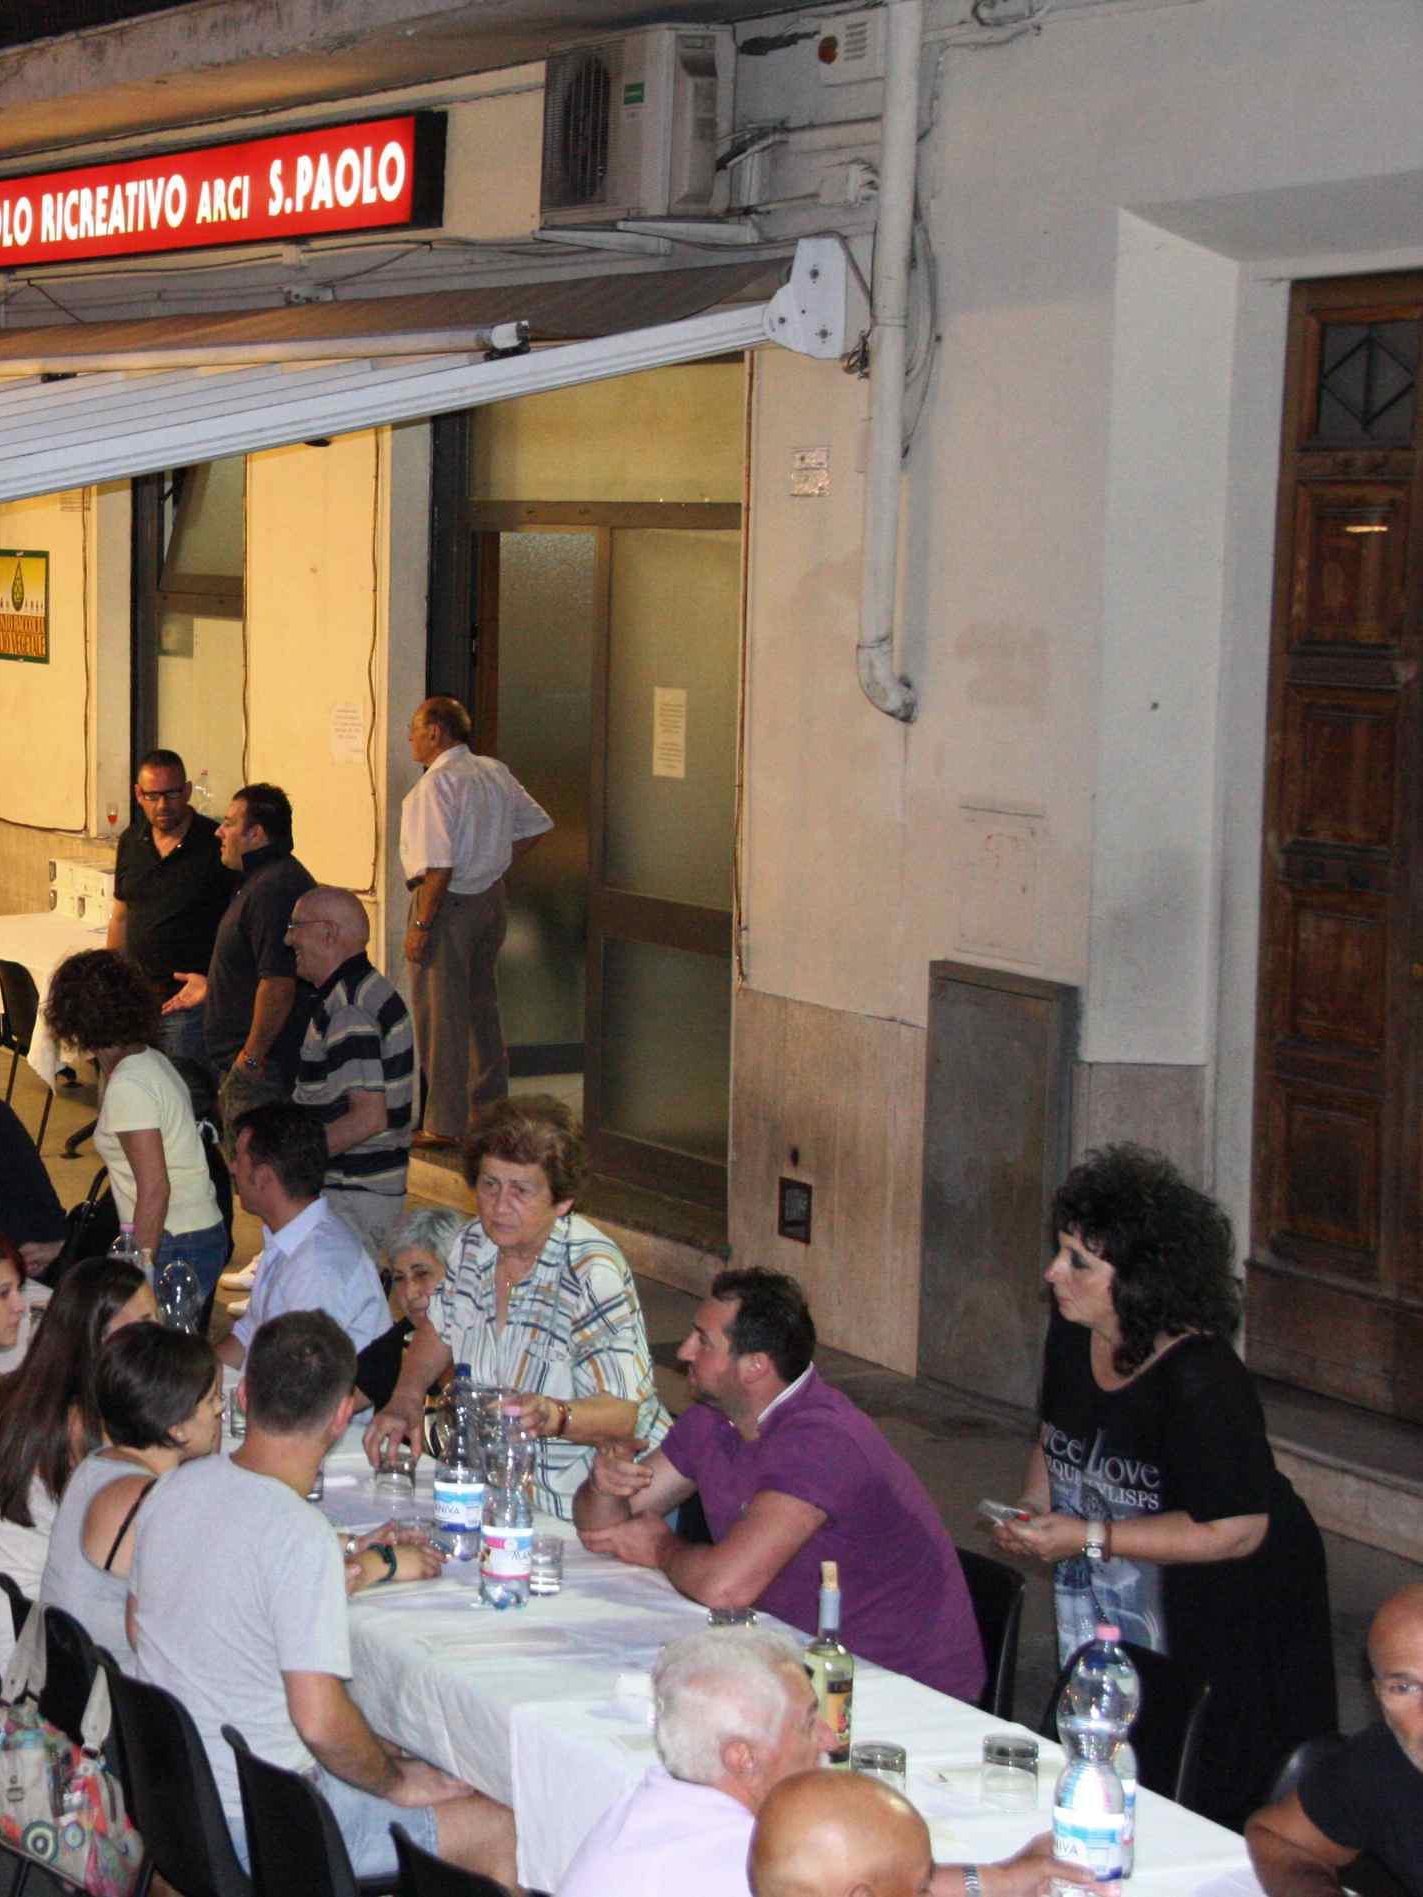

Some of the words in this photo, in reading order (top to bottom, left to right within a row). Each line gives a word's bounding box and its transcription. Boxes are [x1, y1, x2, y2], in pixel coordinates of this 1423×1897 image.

[40, 173, 187, 243] RICREATIVO
[195, 175, 250, 224] ARCI
[268, 141, 406, 217] S.PAOLO
